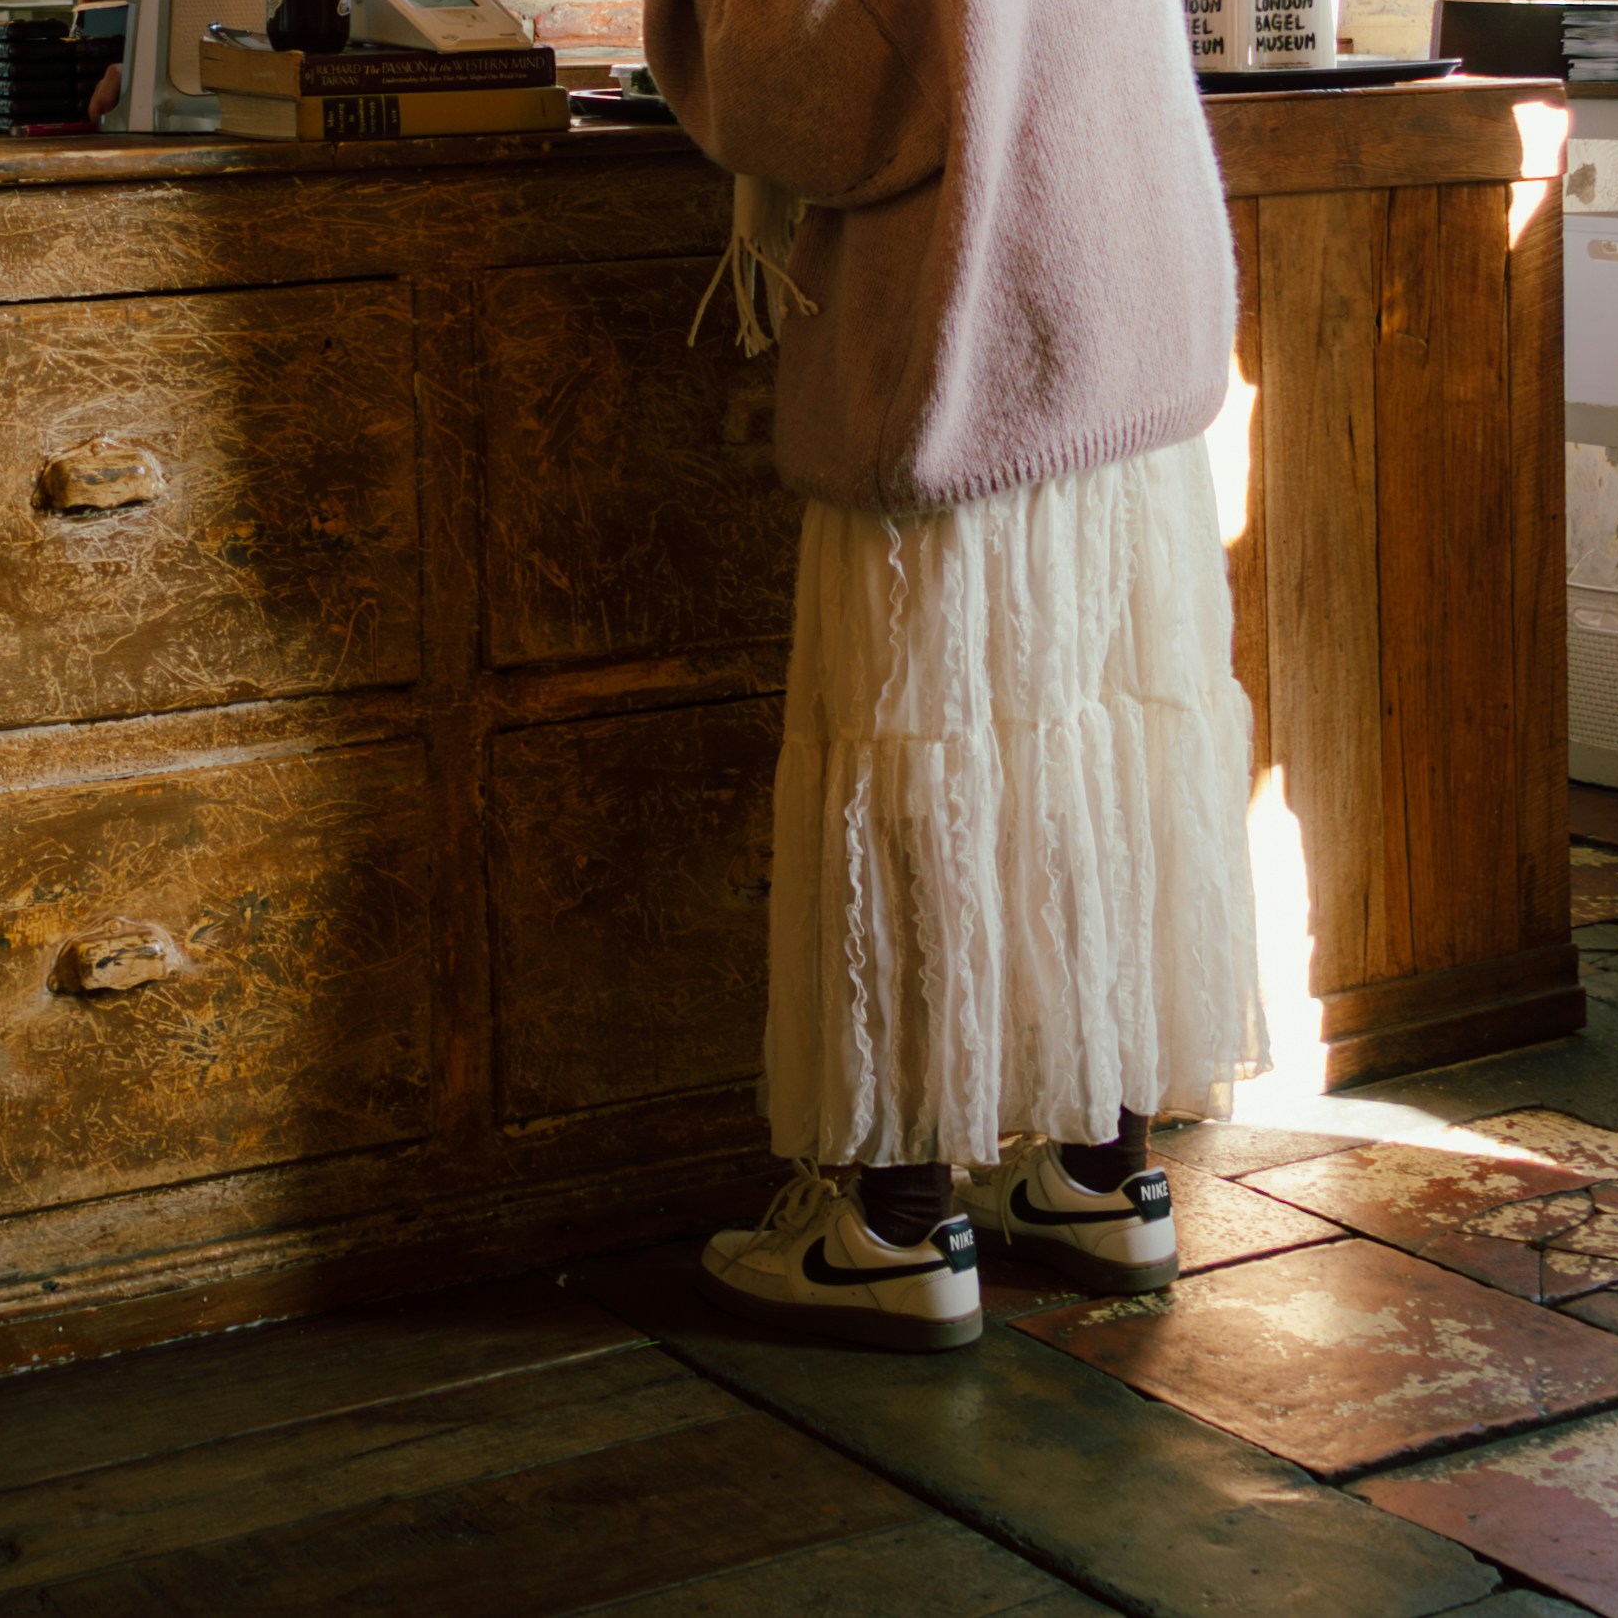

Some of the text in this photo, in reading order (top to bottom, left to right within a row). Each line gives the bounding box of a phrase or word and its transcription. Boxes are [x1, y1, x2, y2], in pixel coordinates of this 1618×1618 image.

[1255, 13, 1305, 32] BAGEL
[1256, 32, 1316, 52] MUSEUM
[316, 64, 361, 76] RICHARD
[364, 65, 380, 75] The
[381, 62, 429, 74] PASSION
[452, 57, 510, 72] WESTERN
[511, 55, 546, 69] MIND
[322, 75, 359, 87] TARNAS
[1140, 1180, 1168, 1201] NIKE
[949, 1228, 974, 1251] NIKE
